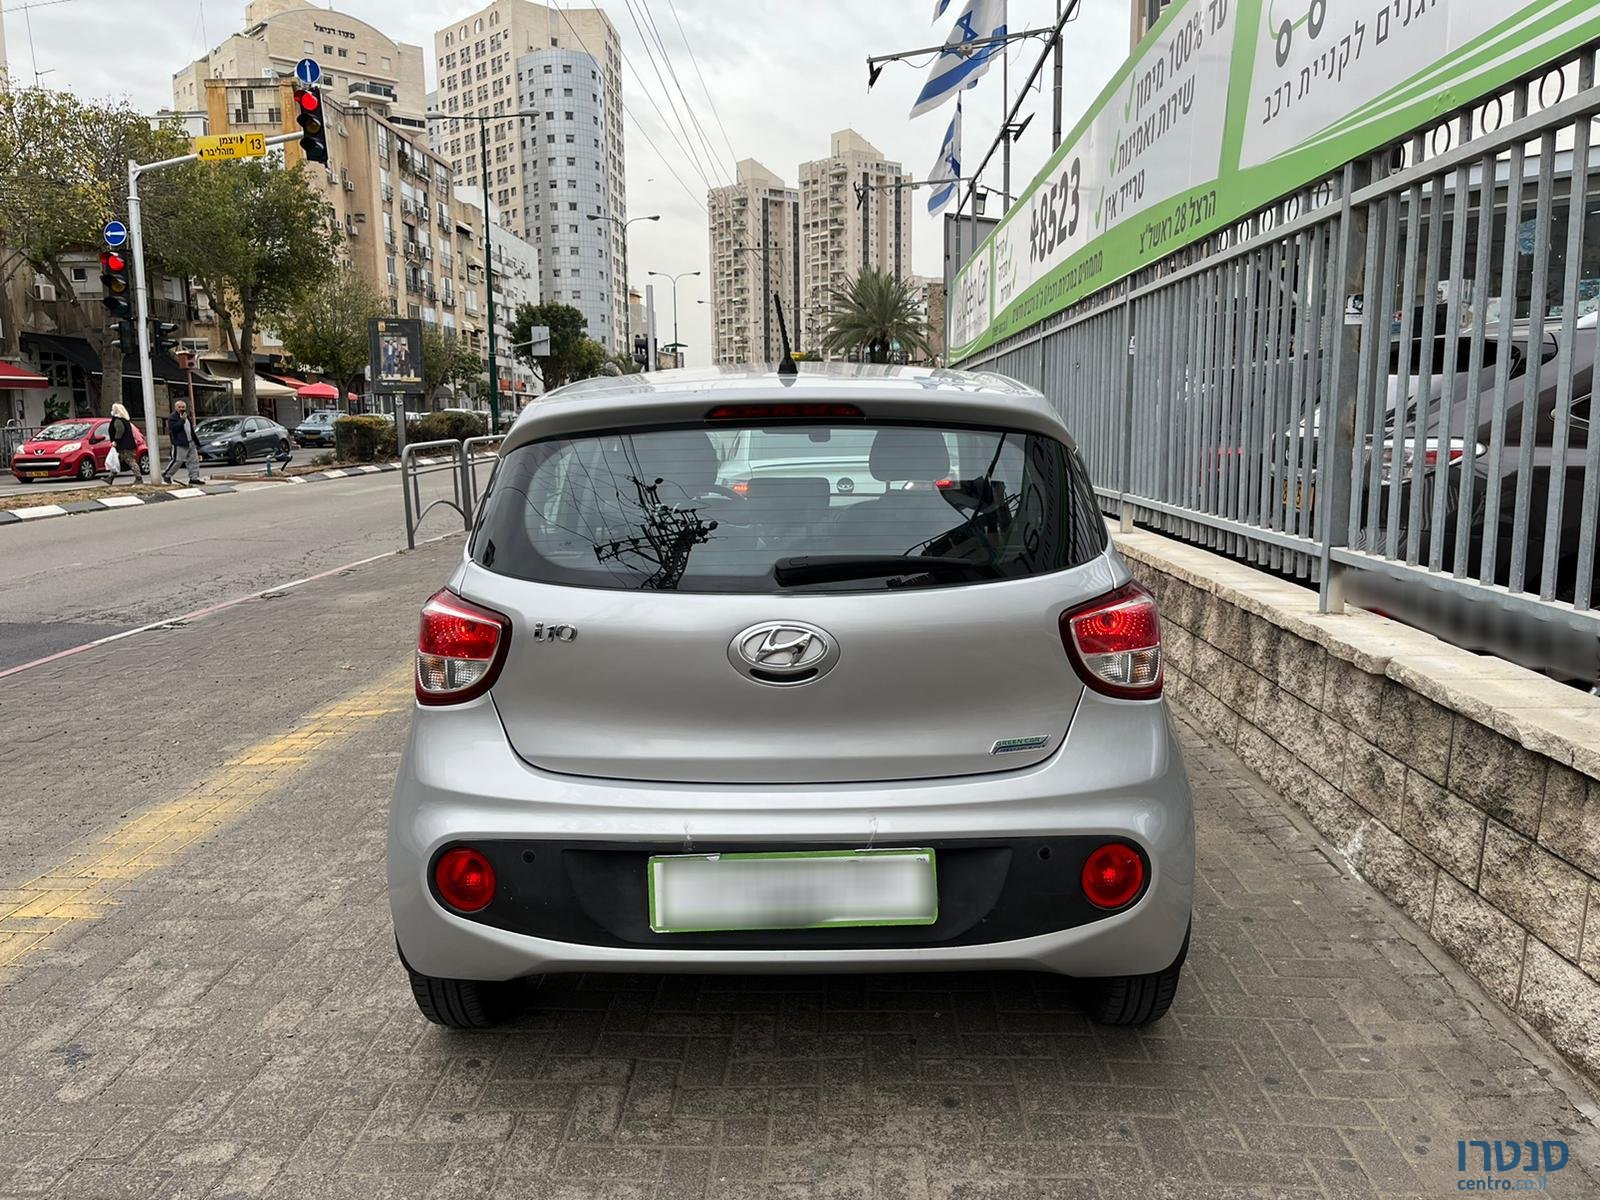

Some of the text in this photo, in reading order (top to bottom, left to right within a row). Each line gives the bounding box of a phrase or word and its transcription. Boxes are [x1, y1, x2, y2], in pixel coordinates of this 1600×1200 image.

[1169, 11, 1202, 78] 100%
[1298, 20, 1366, 100] לקניית
[1136, 57, 1165, 122] מימון
[1263, 81, 1292, 124] רכב
[219, 136, 239, 147] ויצמן
[250, 138, 262, 150] 13
[1118, 74, 1196, 174] שירות ואמינות
[205, 146, 235, 156] מוהליבר
[1104, 168, 1145, 232] טרייד אין
[1174, 201, 1187, 236] 28
[1189, 190, 1216, 228] הרצל
[534, 621, 577, 642] i10
